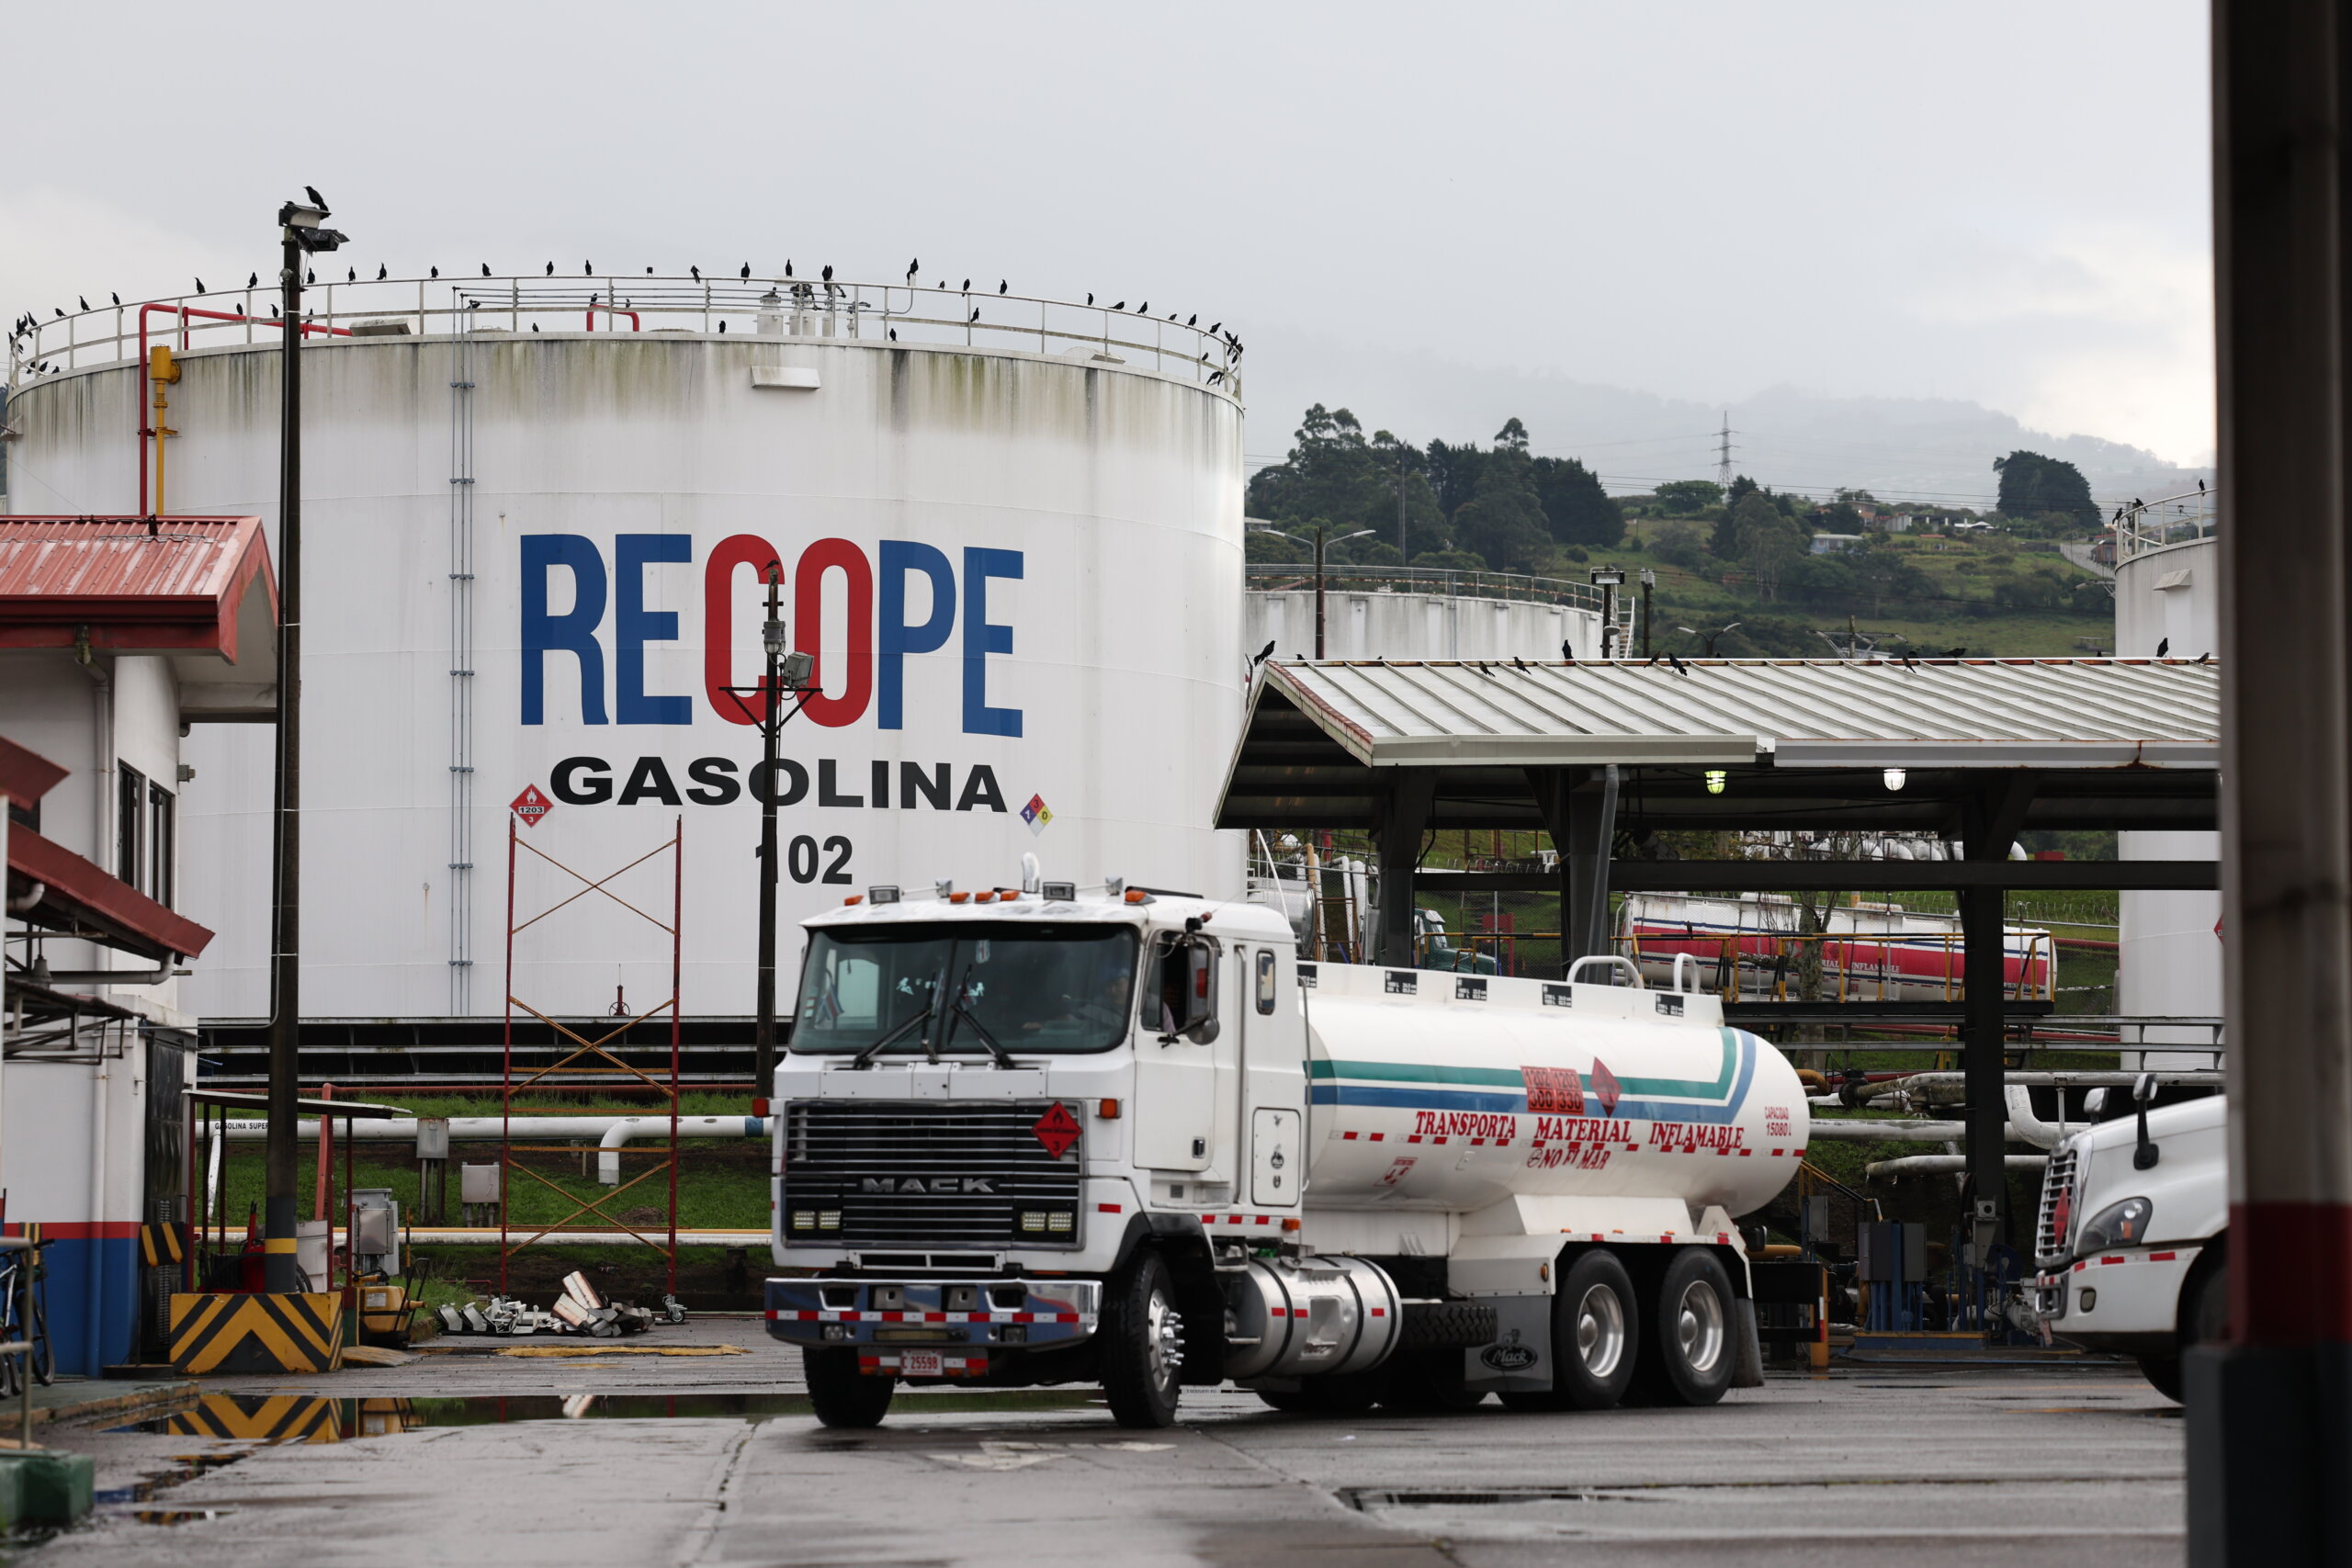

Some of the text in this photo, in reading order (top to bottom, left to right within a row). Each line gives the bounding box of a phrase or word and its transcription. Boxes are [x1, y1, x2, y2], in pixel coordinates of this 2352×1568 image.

[520, 534, 1023, 738] RECOPE
[549, 756, 1008, 812] GASOLINA
[1034, 799, 1039, 808] 3
[1555, 1072, 1578, 1089] 1203
[1559, 1091, 1581, 1110] 330
[1415, 1111, 1744, 1148] TRANSPORTA MATERIAL INFLAMABLE
[1767, 1122, 1787, 1135] 15080
[1538, 1148, 1563, 1168] NO
[863, 1178, 994, 1193] MACK
[1491, 1349, 1528, 1365] Mack
